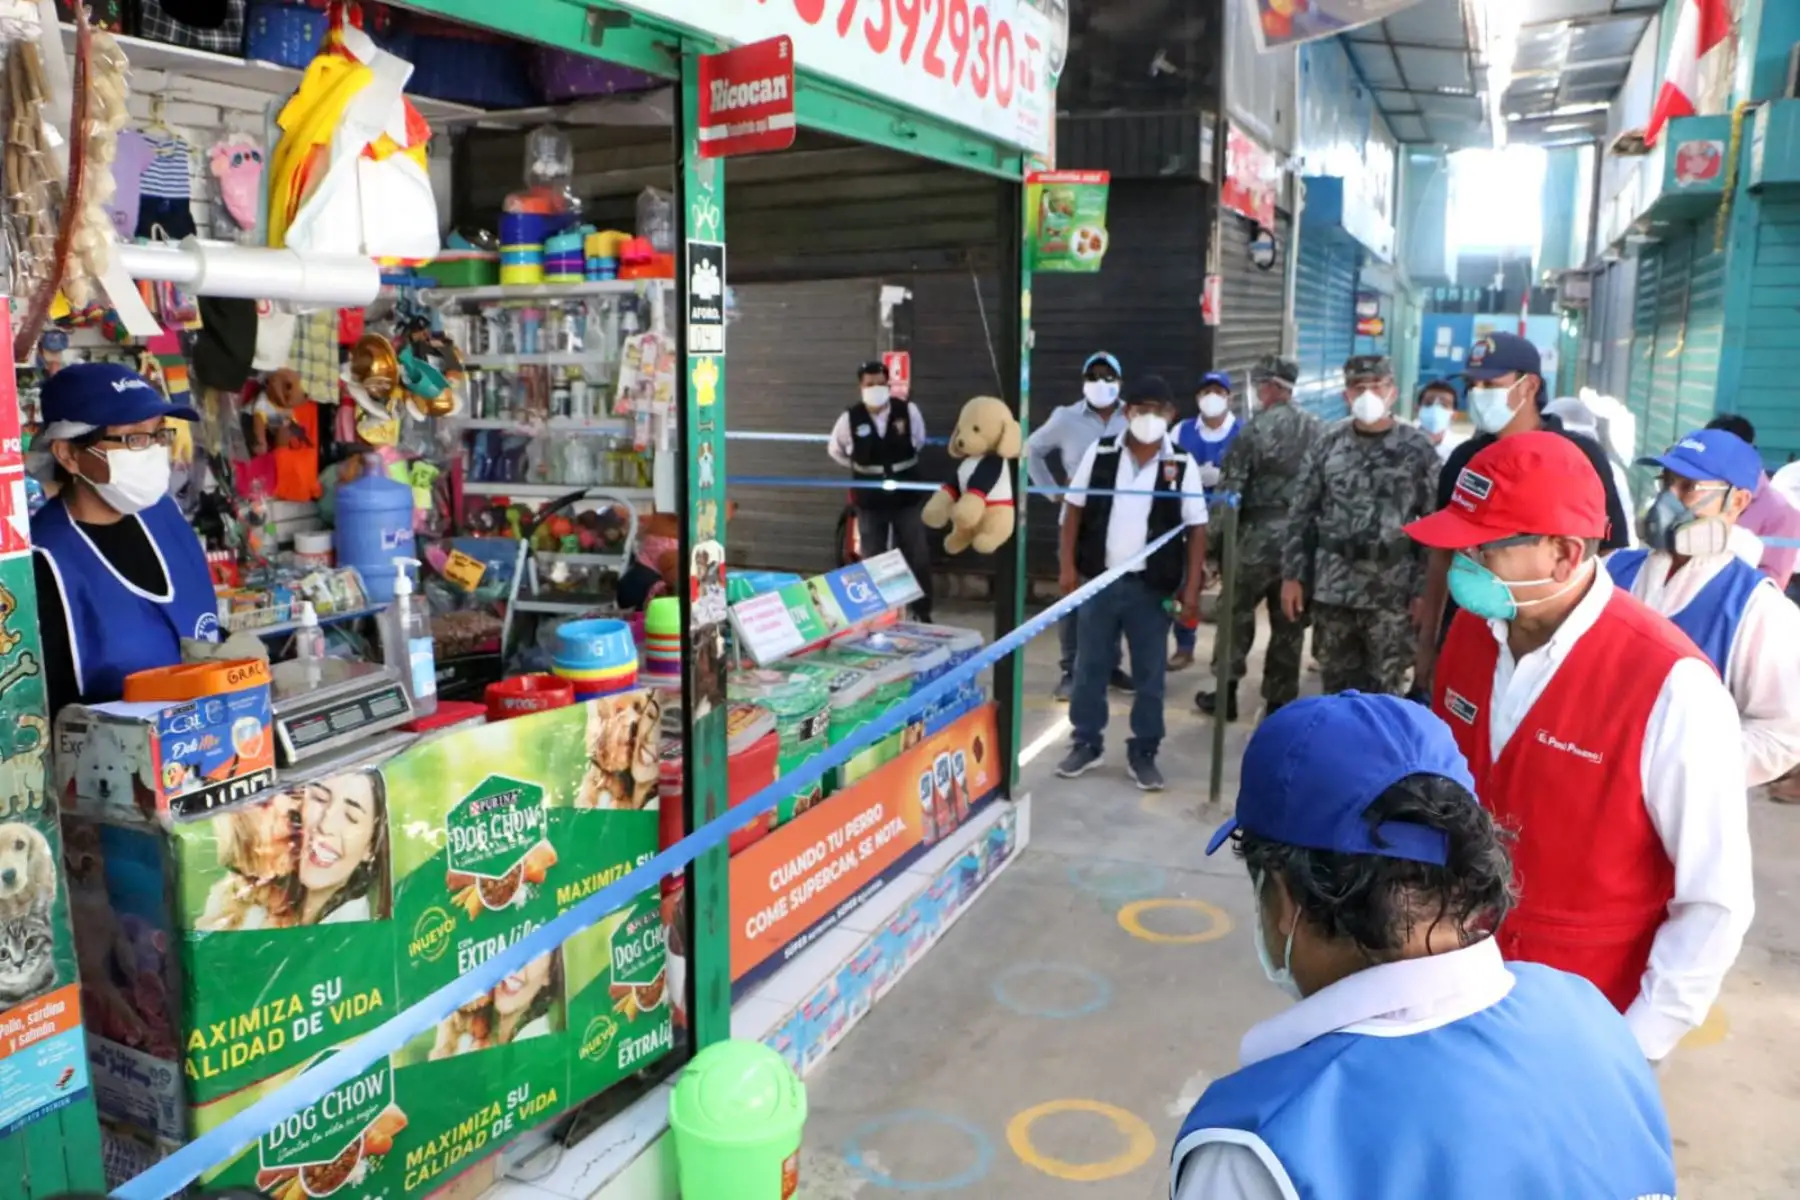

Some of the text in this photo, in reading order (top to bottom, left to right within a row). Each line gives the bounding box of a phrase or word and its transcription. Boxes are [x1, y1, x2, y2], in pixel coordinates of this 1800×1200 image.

[710, 75, 787, 113] Ricocan
[452, 821, 488, 855] DOG
[491, 804, 541, 839] CHOW
[769, 841, 826, 892] CUANDO
[827, 828, 845, 852] TU
[844, 803, 884, 842] PERRO
[556, 861, 633, 906] MAXIMIZA
[745, 895, 789, 940] COME
[858, 836, 875, 860] SE
[614, 939, 642, 970] DOG
[643, 923, 665, 951] CHO
[185, 1027, 285, 1080] ALIDAD
[293, 1011, 324, 1042] DE
[329, 988, 383, 1024] VIDA
[187, 976, 342, 1051] AXIMIZA SU
[268, 1069, 386, 1150] DOG CHOW
[404, 1088, 558, 1191] CALIDAD DE VIDA
[406, 1082, 529, 1170] MAXIMIZA SU
